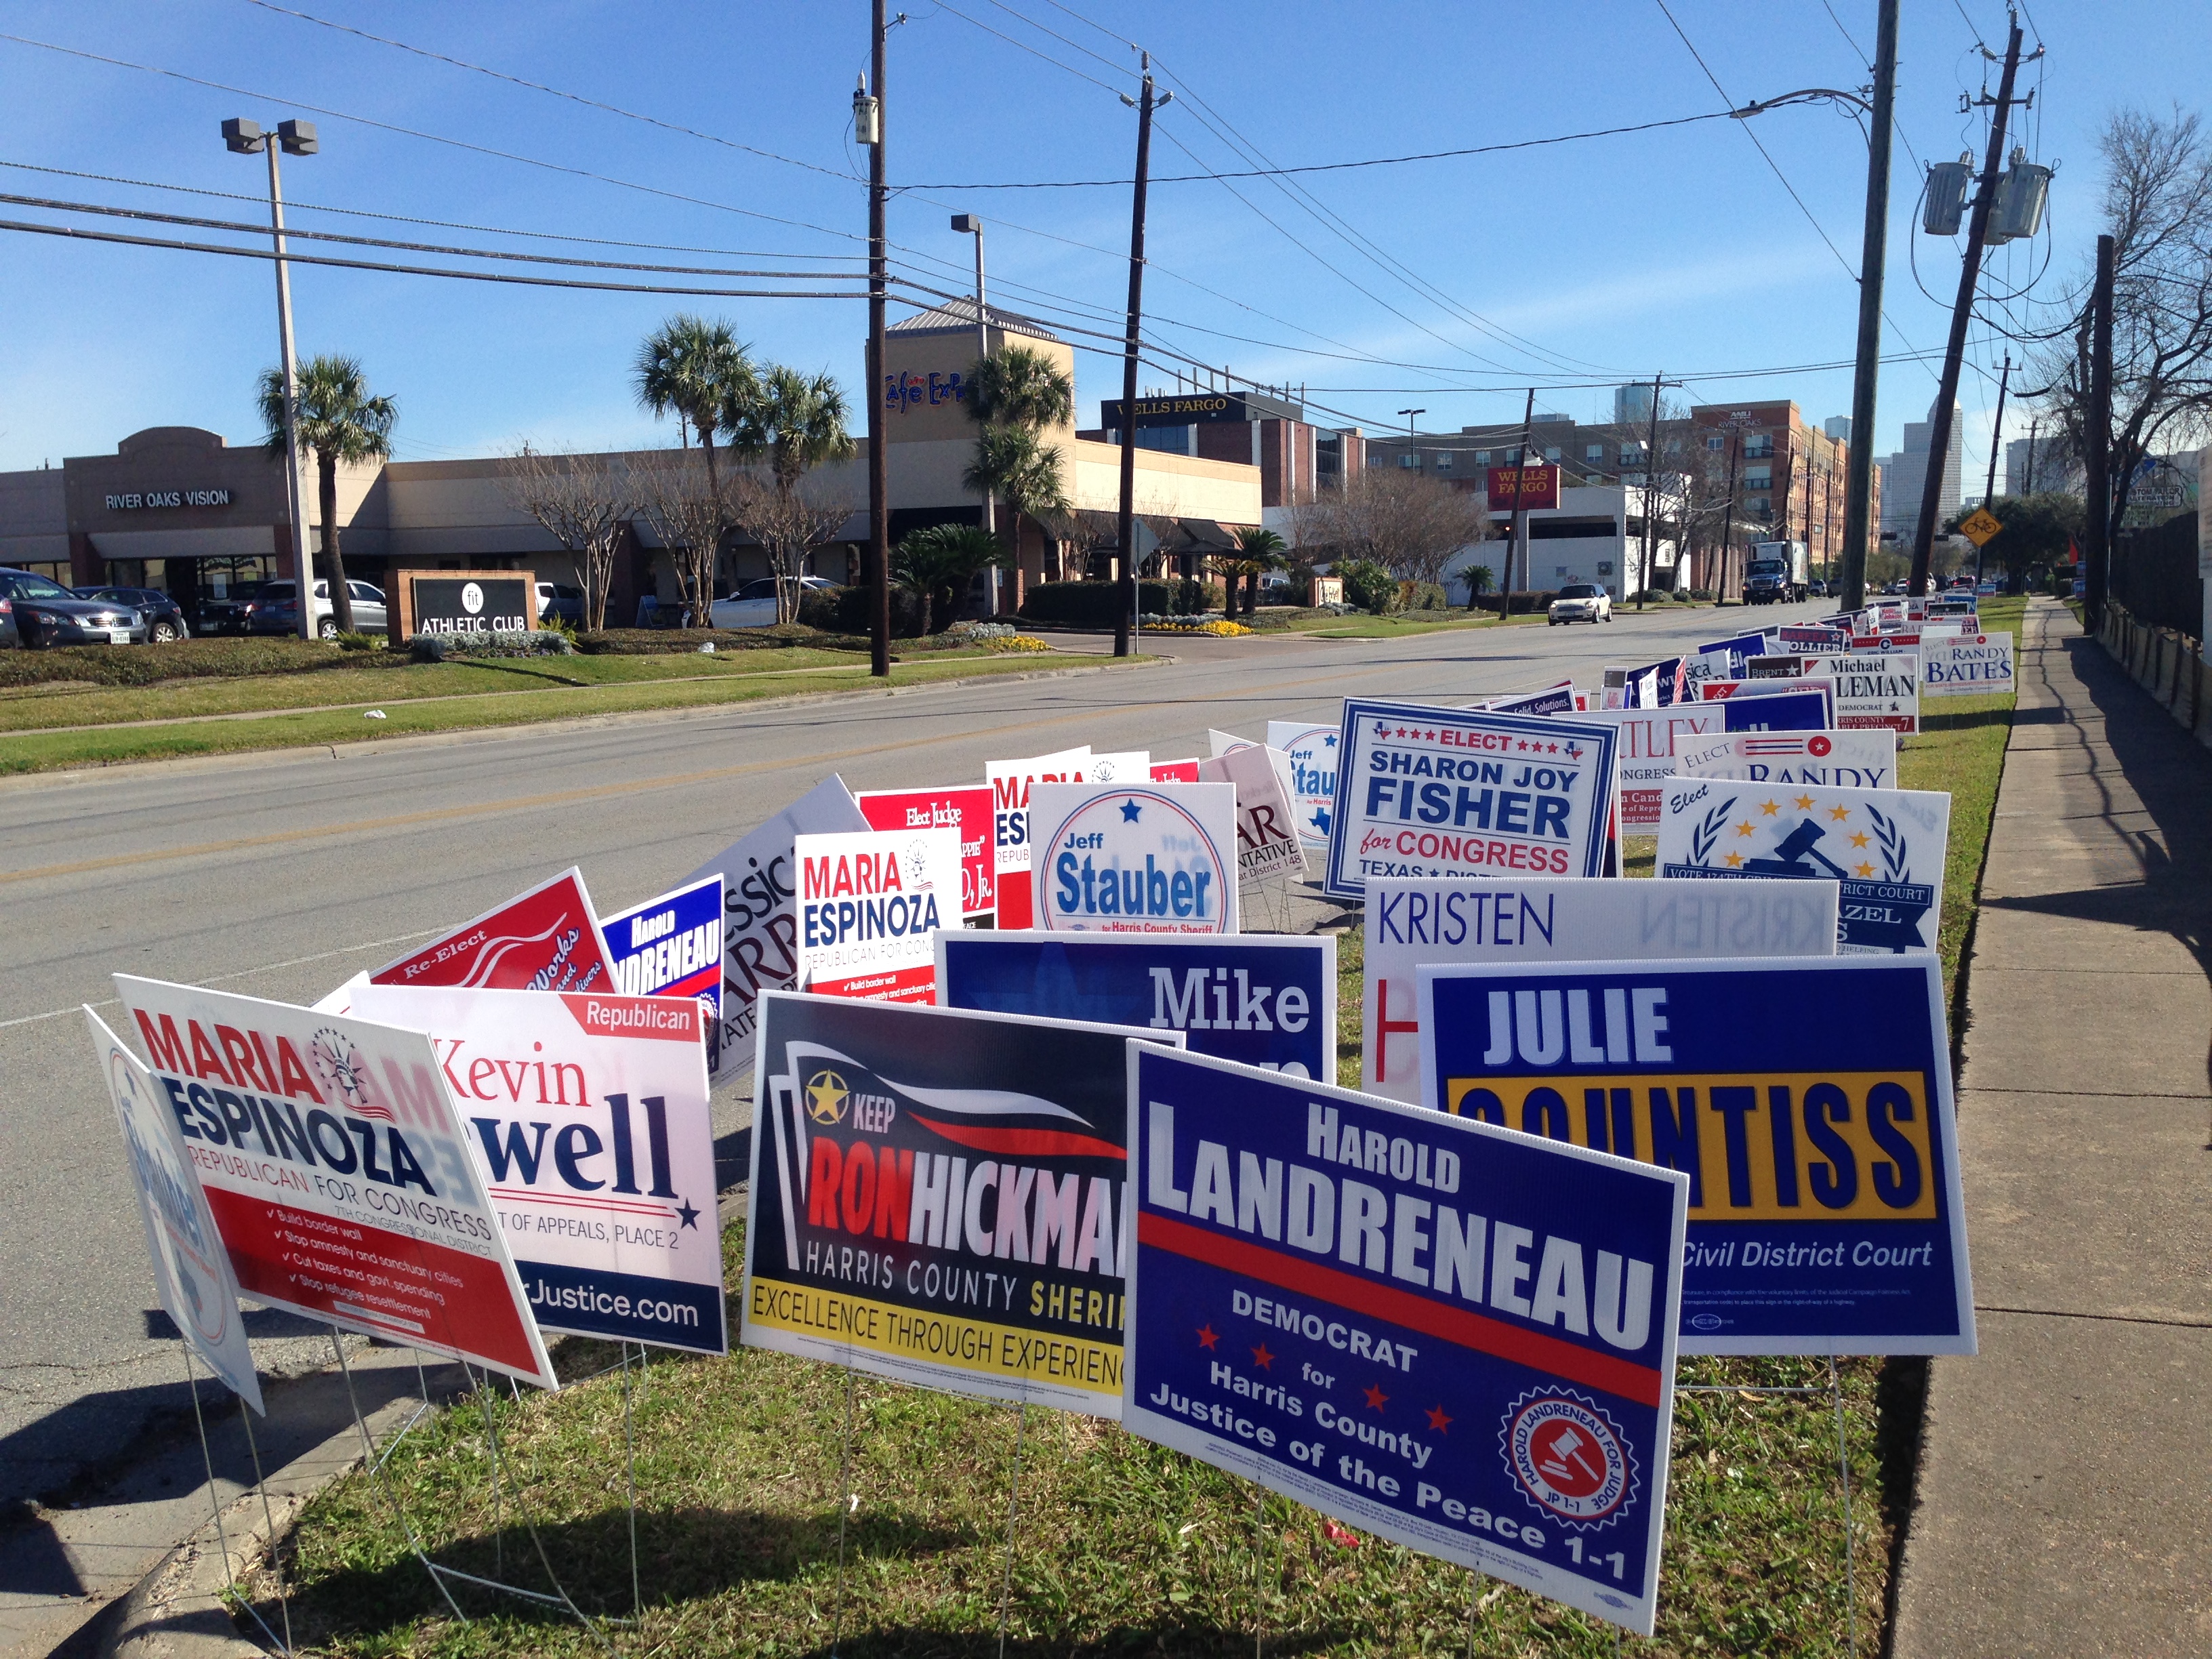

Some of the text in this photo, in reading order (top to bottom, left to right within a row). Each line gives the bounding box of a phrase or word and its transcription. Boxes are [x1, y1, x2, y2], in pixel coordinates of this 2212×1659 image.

[1174, 398, 1227, 412] FARGO
[1740, 418, 1761, 427] OAKS
[106, 490, 228, 508] RIVER OAKS VISION
[1498, 482, 1547, 493] FARGO
[468, 591, 478, 605] fit
[422, 616, 525, 634] ATHLETIC CLUB
[1925, 640, 1944, 651] ELECT
[1953, 647, 2008, 660] RANDY
[1830, 659, 1885, 673] Michael
[1925, 661, 2011, 683] BATES
[1836, 675, 1915, 698] LEMAN
[1535, 698, 1570, 713] Solutions.
[1439, 729, 1512, 751] ELECT
[1901, 717, 1909, 731] 7
[1290, 750, 1313, 760] Jeff
[1370, 750, 1579, 792] SHARON JOY
[1684, 742, 1731, 769] ELECT
[906, 801, 962, 827] Elect Judge
[1366, 776, 1571, 839] FISHER
[1671, 783, 1709, 815] Elect
[1064, 833, 1104, 849] Jeff
[1359, 828, 1569, 874] for CONGRESS
[804, 852, 902, 900] MARIA
[1250, 863, 1282, 876] District
[1284, 854, 1302, 867] 148
[1359, 859, 1423, 878] TEXAS
[1671, 869, 1702, 878] VOTE
[1056, 851, 1211, 918] Stauber
[1878, 886, 1925, 900] COURT
[632, 910, 675, 949] HAROLD
[804, 893, 940, 948] ESPINOZA
[1113, 922, 1141, 933] Harris
[1144, 922, 1178, 933] County
[1181, 924, 1212, 934] Sheriff
[1379, 893, 1554, 946] KRISTEN
[1839, 905, 1902, 924] ZEL
[404, 930, 488, 979] Re-Elect
[526, 928, 579, 991] Works
[805, 947, 876, 970] REPUBLICAN
[881, 943, 901, 958] FOR
[555, 963, 576, 991] and
[851, 975, 896, 991] Build border wall
[889, 987, 900, 998] and
[901, 983, 926, 997] sanctuary
[587, 1002, 691, 1031] Republican
[1149, 968, 1309, 1033] Mike
[1483, 987, 1673, 1065] JULIE
[133, 1008, 326, 1105] MARIA
[433, 1039, 592, 1108] Kevin
[853, 1092, 897, 1134] KEEP
[161, 1076, 437, 1197] ESPINOZA
[466, 1092, 678, 1200] well
[1307, 1103, 1462, 1194] HAROLD
[1457, 1081, 1922, 1211] UNTISS
[188, 1145, 491, 1241] REPUBLICAN FOR CONGRESS
[276, 1209, 363, 1241] Build border wall
[335, 1206, 491, 1256] 7TH CONGRESSIONAL DISTRICT
[512, 1213, 678, 1249] OF APPEALS, PLACE 2
[1148, 1101, 1654, 1351] LANDRENEAU
[285, 1229, 464, 1288] Stop amnesty and sanctuary cities
[1683, 1240, 1933, 1267] Civil District Court
[293, 1252, 312, 1268] Cut
[314, 1258, 341, 1275] taxes
[343, 1267, 369, 1282] and
[394, 1280, 445, 1306] spending
[807, 1242, 893, 1289] HARRIS
[907, 1261, 1016, 1311] COUNTY
[299, 1274, 323, 1292] Stop
[325, 1282, 365, 1302] refugee
[366, 1292, 432, 1319] resettlement
[754, 1285, 878, 1340] EXCELLENCE
[887, 1312, 993, 1364] THROUGH
[1232, 1289, 1418, 1373] DEMOCRAT
[1301, 1361, 1336, 1390] for
[1210, 1361, 1433, 1470] Harris County
[1515, 1403, 1622, 1510] HAROLD LANDRENEAU FOR JUDGE
[1150, 1384, 1626, 1581] Justice of the Peace 1-1
[1544, 1492, 1580, 1513] JP 1-1
